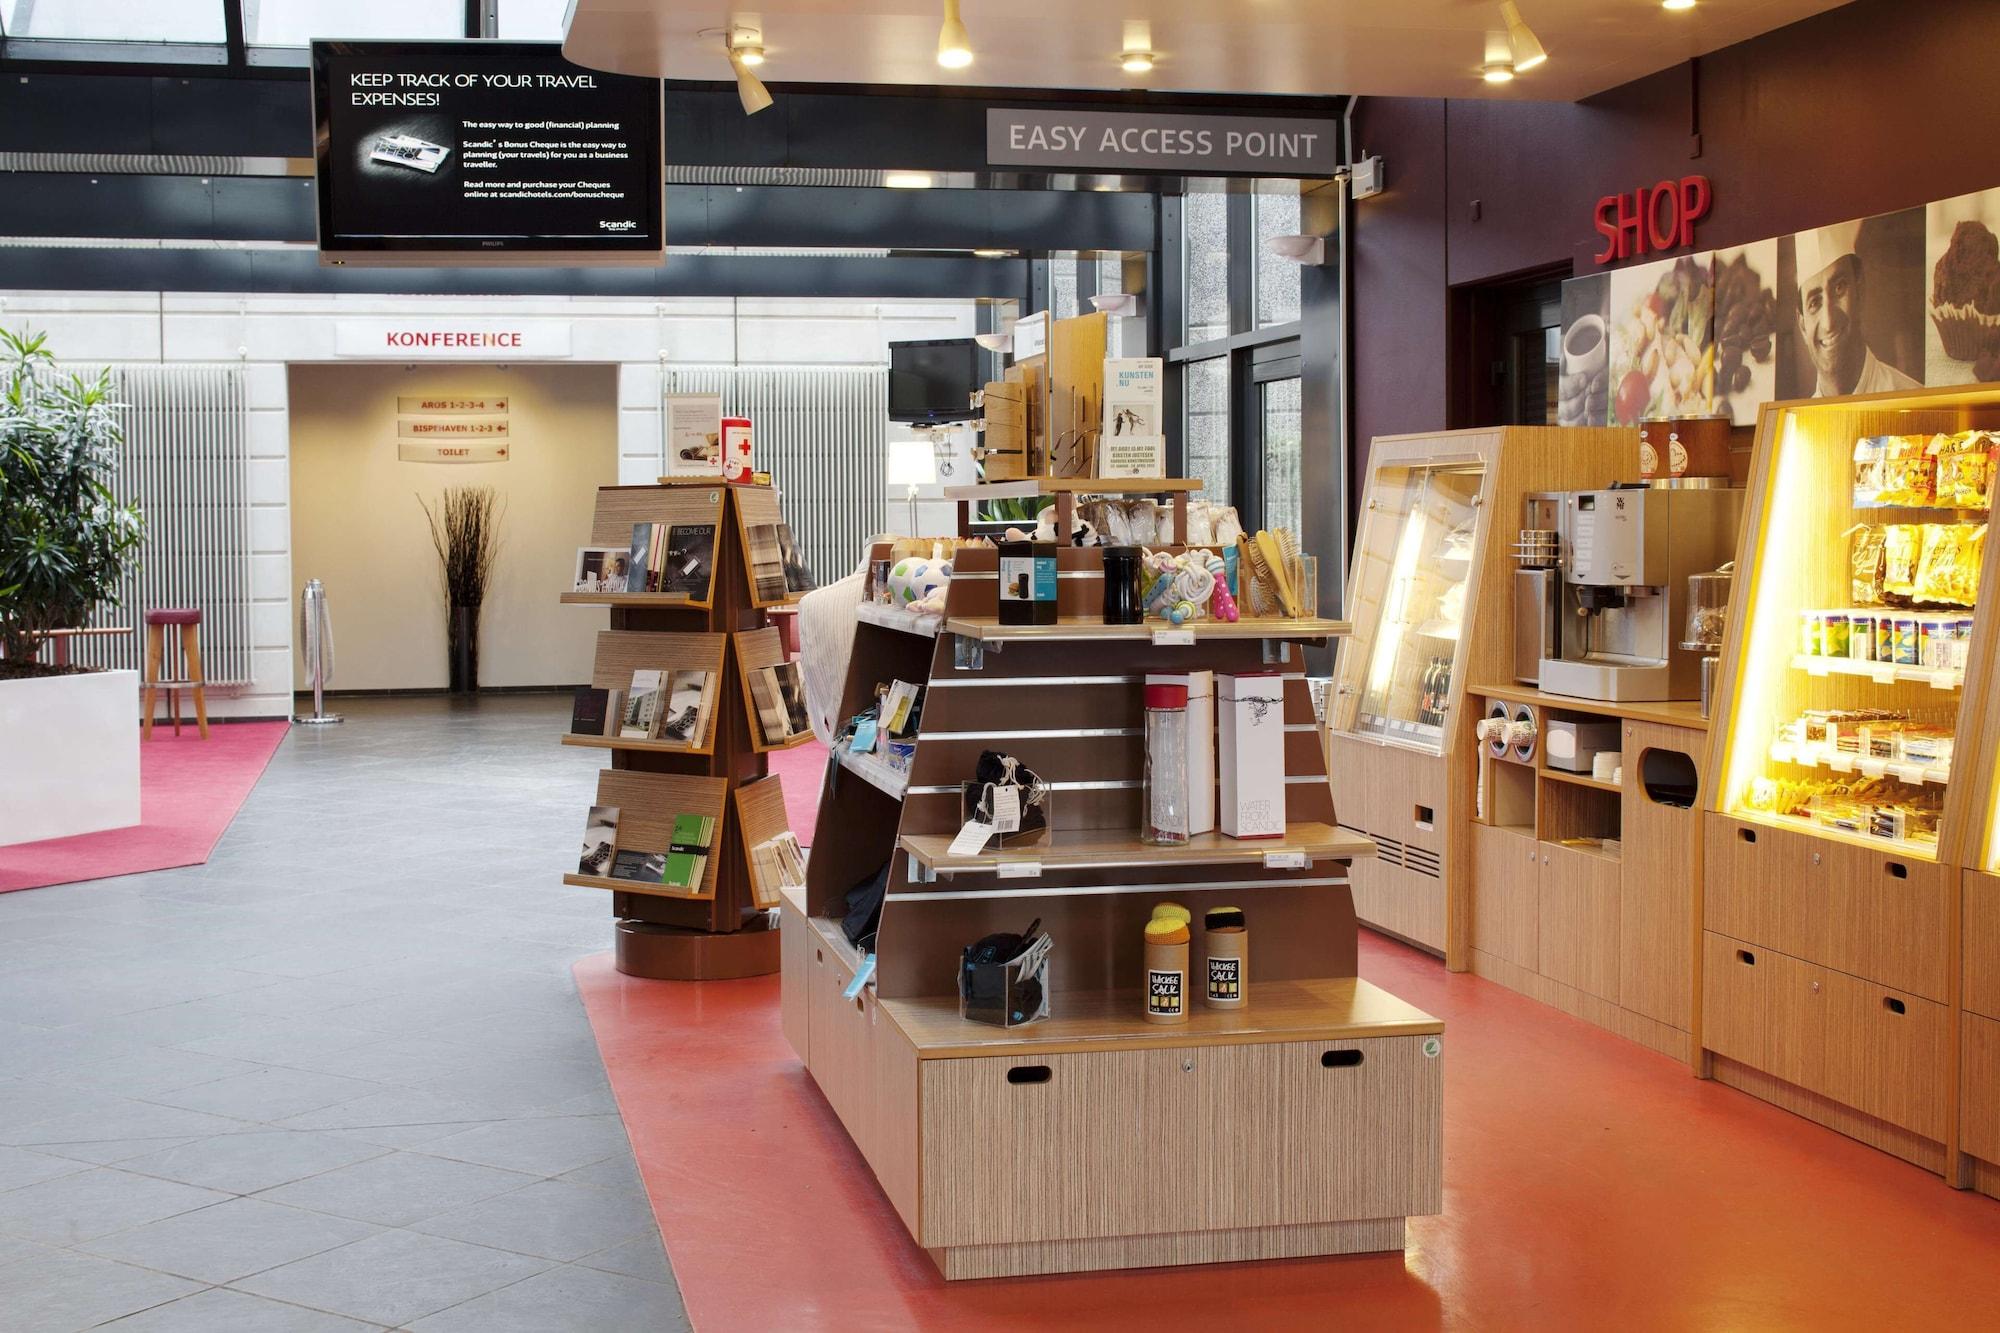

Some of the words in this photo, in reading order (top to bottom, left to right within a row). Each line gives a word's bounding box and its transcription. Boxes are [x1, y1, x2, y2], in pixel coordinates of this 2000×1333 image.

[350, 73, 393, 87] KEEP
[397, 74, 450, 88] TRACK
[455, 74, 478, 88] OF
[482, 74, 532, 88] YOUR
[538, 75, 597, 88] TRAVEL
[351, 92, 440, 106] EXPENSES!
[525, 121, 544, 129] good
[546, 121, 584, 130] (financial)
[585, 122, 619, 130] planning
[1010, 124, 1087, 152] EASY
[1099, 127, 1212, 155] ACCESS
[1227, 132, 1318, 158] POINT
[463, 152, 497, 160] planning
[1594, 175, 1712, 264] SHOP
[387, 332, 522, 347] KONFERENCE
[1240, 800, 1270, 810] WATER
[1240, 811, 1270, 821] FROM
[1211, 971, 1237, 981] SACK
[1152, 984, 1178, 994] SACK
